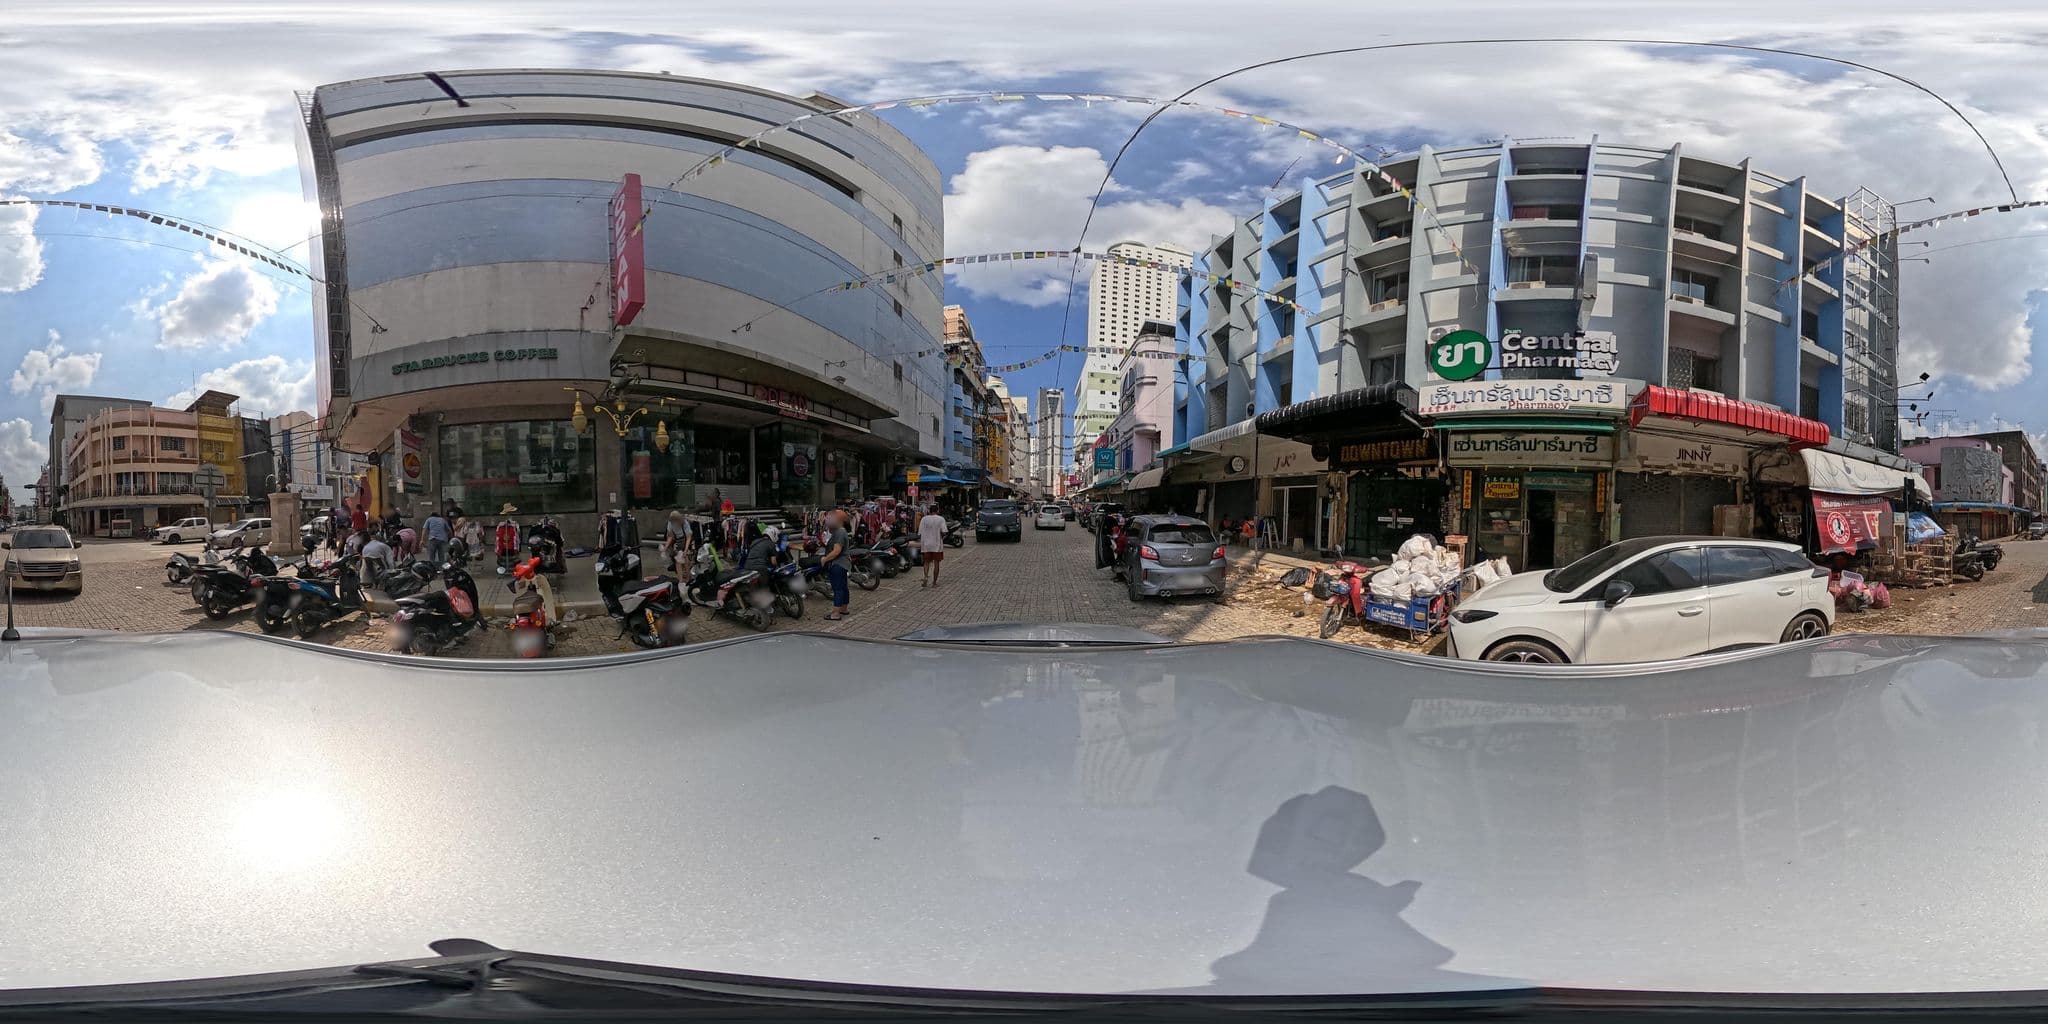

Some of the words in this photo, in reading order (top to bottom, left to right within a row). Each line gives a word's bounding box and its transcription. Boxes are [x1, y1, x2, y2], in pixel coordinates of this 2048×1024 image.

[1437, 341, 1485, 367] ยา
[1501, 332, 1618, 354] Central
[391, 351, 490, 375] STARBUCKS
[494, 348, 559, 361] COFFEE
[1501, 352, 1620, 375] Pharmacy
[1508, 401, 1569, 410] Pharmacy
[1341, 439, 1428, 462] DOWNTOWN
[1676, 448, 1712, 462] JINNY
